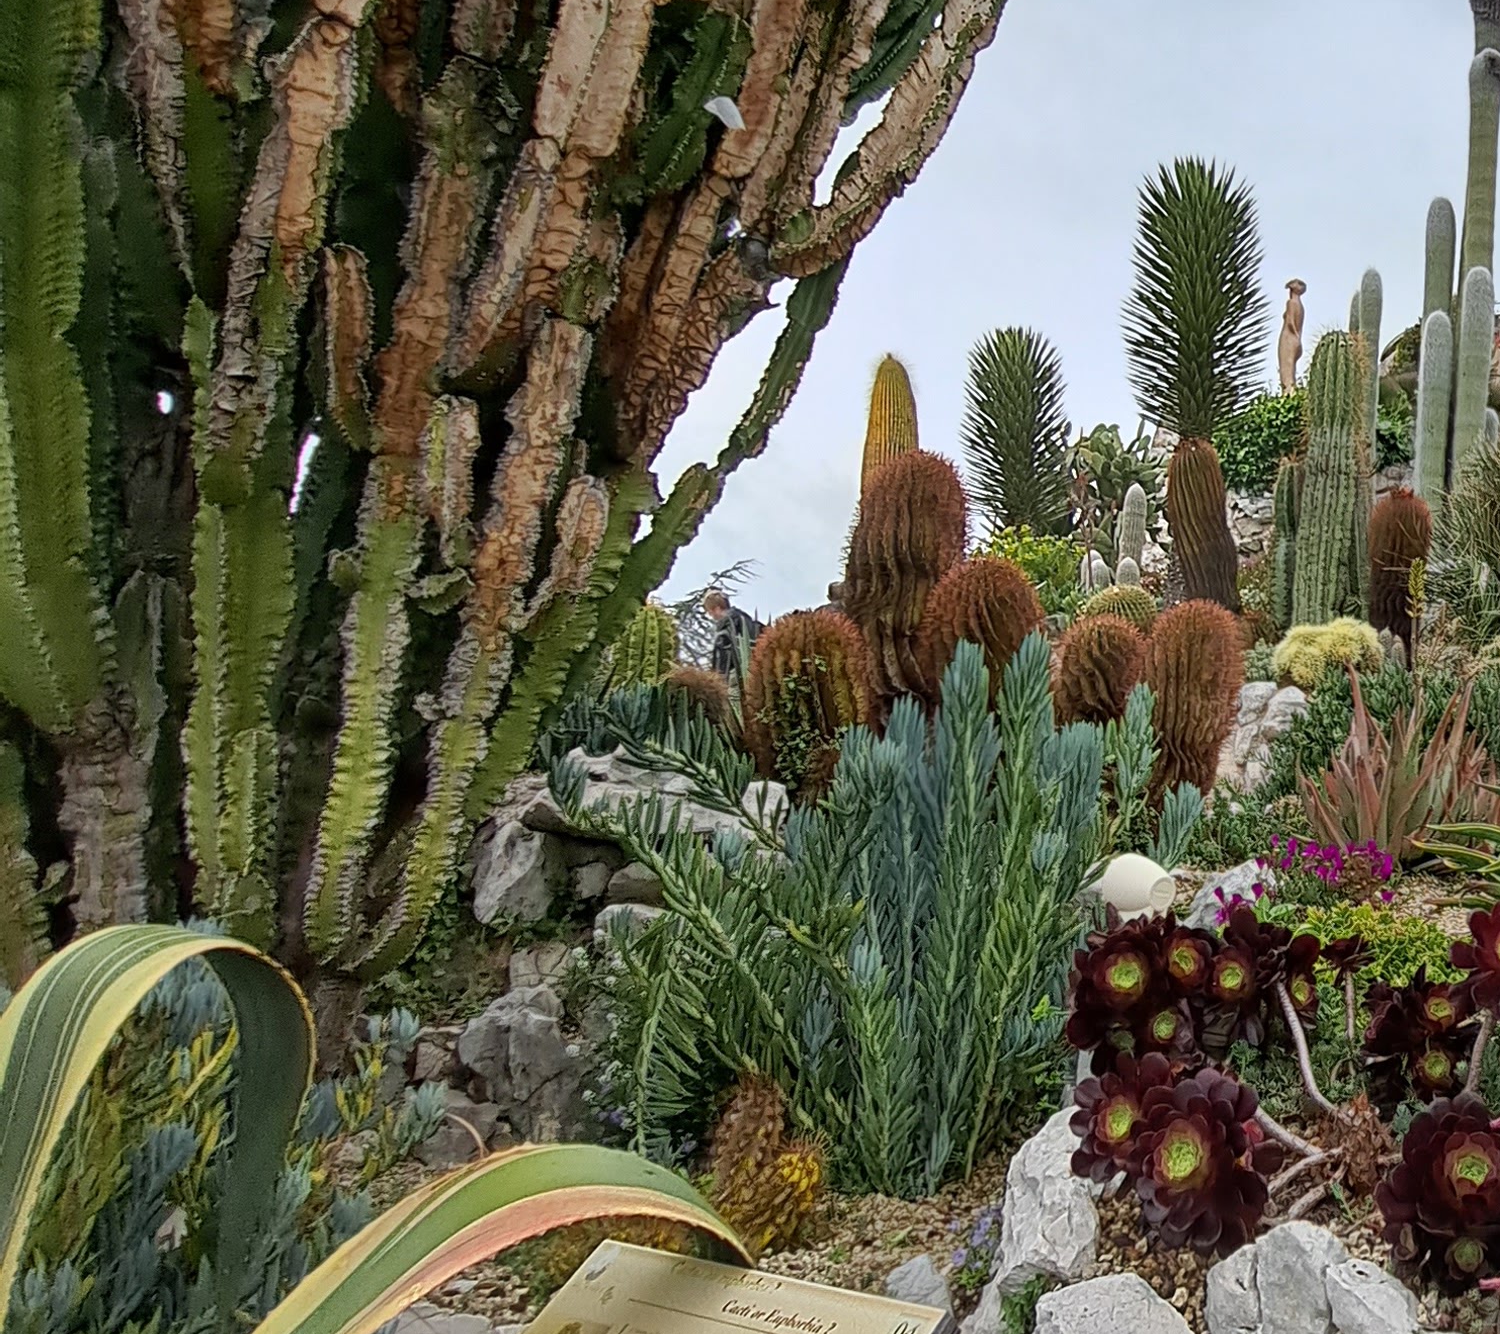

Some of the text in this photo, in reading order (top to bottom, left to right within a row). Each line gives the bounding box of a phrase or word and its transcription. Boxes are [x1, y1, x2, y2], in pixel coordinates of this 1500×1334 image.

[721, 1299, 756, 1318] Cacti
[750, 1307, 766, 1319] or
[764, 1308, 823, 1334] Euphorbia
